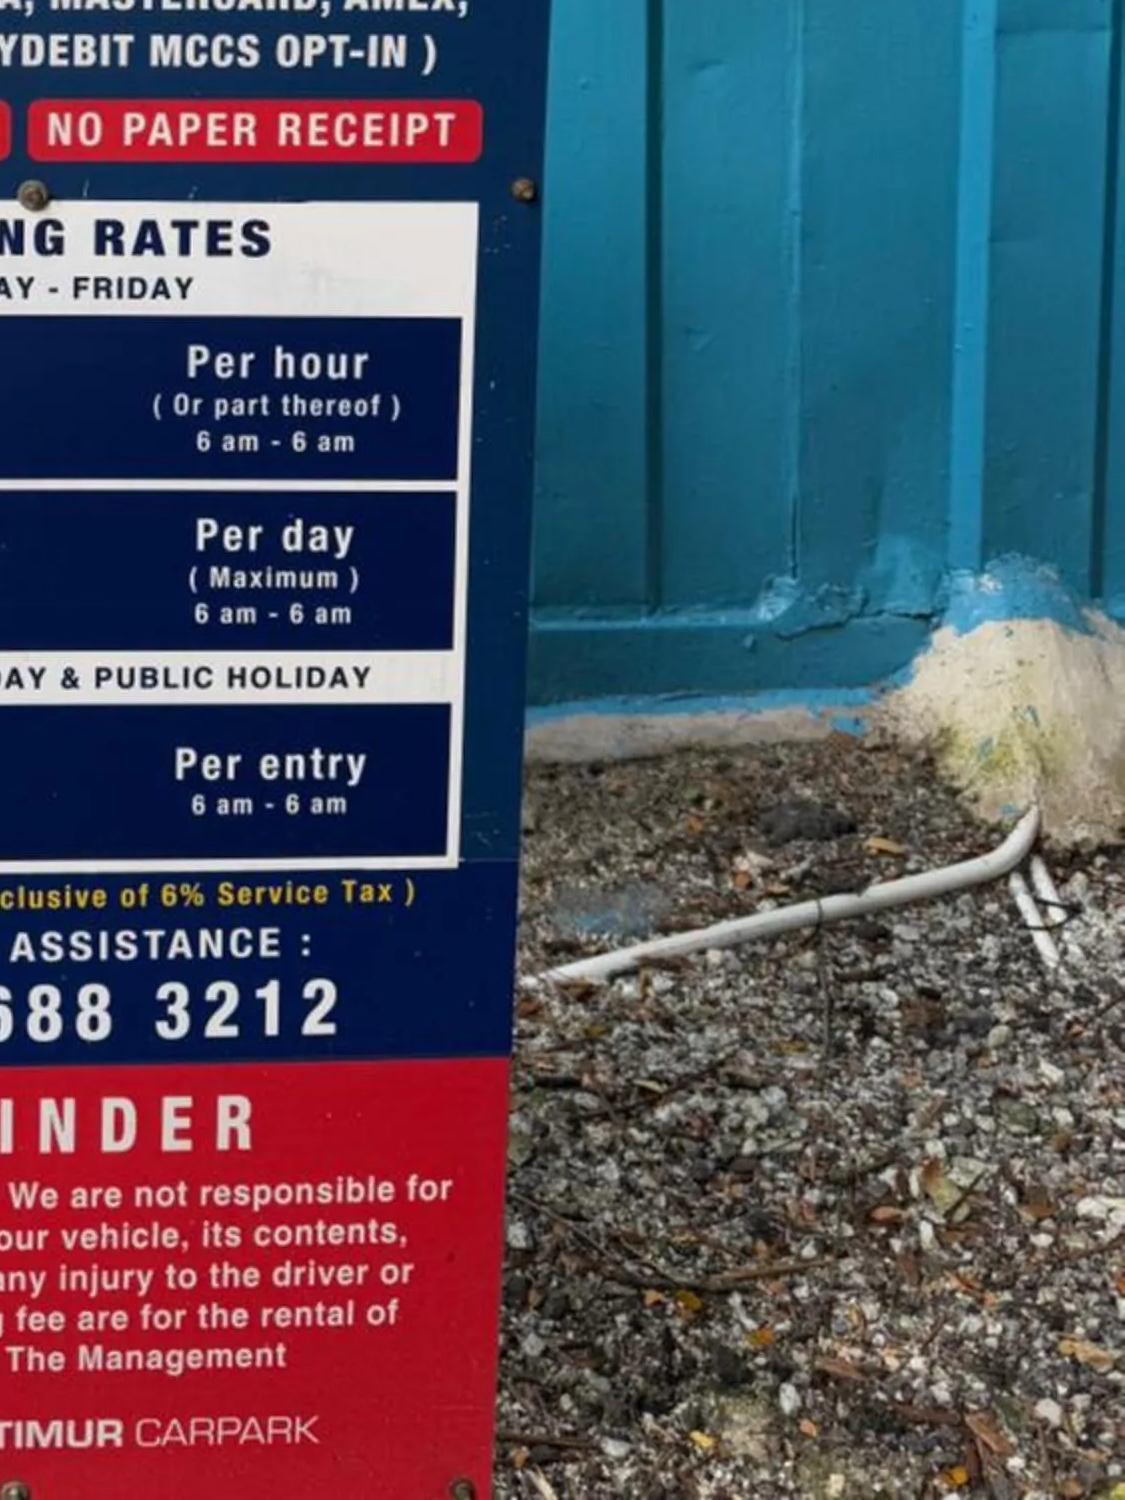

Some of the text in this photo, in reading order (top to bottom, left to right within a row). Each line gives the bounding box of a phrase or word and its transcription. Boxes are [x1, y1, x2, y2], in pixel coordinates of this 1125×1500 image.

[150, 33, 260, 68] MCCS
[276, 33, 407, 68] OPT-IN
[48, 111, 456, 147] NO PAPER RECEIPT
[94, 218, 271, 258] RATES
[72, 276, 193, 300] FRIDAY
[187, 344, 369, 380] Per hour
[173, 392, 203, 416] Or
[214, 394, 269, 421] part
[281, 393, 380, 417] thereof
[196, 430, 211, 452] 6
[222, 434, 259, 452] am
[292, 430, 307, 453] 6
[317, 435, 355, 453] am
[196, 517, 354, 559] Per day
[209, 565, 338, 589] Maximum
[194, 602, 209, 624] 6
[220, 606, 257, 625] am
[289, 602, 304, 625] 6
[314, 606, 352, 624] am
[60, 666, 80, 690] &
[94, 665, 213, 690] PUBLIC
[227, 665, 371, 690] HOLIDAY
[175, 747, 366, 787] Per entry
[191, 793, 206, 816] 6
[216, 797, 253, 815] am
[285, 793, 300, 815] 6
[310, 796, 347, 815] am
[120, 883, 149, 908] of
[161, 883, 205, 907] 6%
[217, 880, 329, 906] Service
[341, 879, 392, 903] Tax
[9, 927, 280, 963] ASSISTANCE
[155, 978, 337, 1040] 3212
[8, 1181, 59, 1210] We
[70, 1186, 123, 1209] are
[134, 1181, 188, 1208] not
[200, 1175, 395, 1213] responsible
[406, 1173, 453, 1202] for
[60, 1221, 189, 1251] vehicle,
[202, 1220, 242, 1248] its
[253, 1218, 407, 1247] contents,
[59, 1263, 154, 1298] injury
[165, 1264, 198, 1290] to
[209, 1261, 261, 1289] the
[271, 1259, 369, 1287] driver
[380, 1263, 414, 1285] or
[15, 1305, 66, 1332] fee
[76, 1309, 129, 1332] are
[139, 1303, 187, 1331] for
[197, 1302, 250, 1329] the
[260, 1299, 354, 1328] rental
[366, 1297, 399, 1326] of
[5, 1345, 66, 1372] The
[78, 1342, 287, 1377] Management
[134, 1417, 321, 1449] CARPARK
